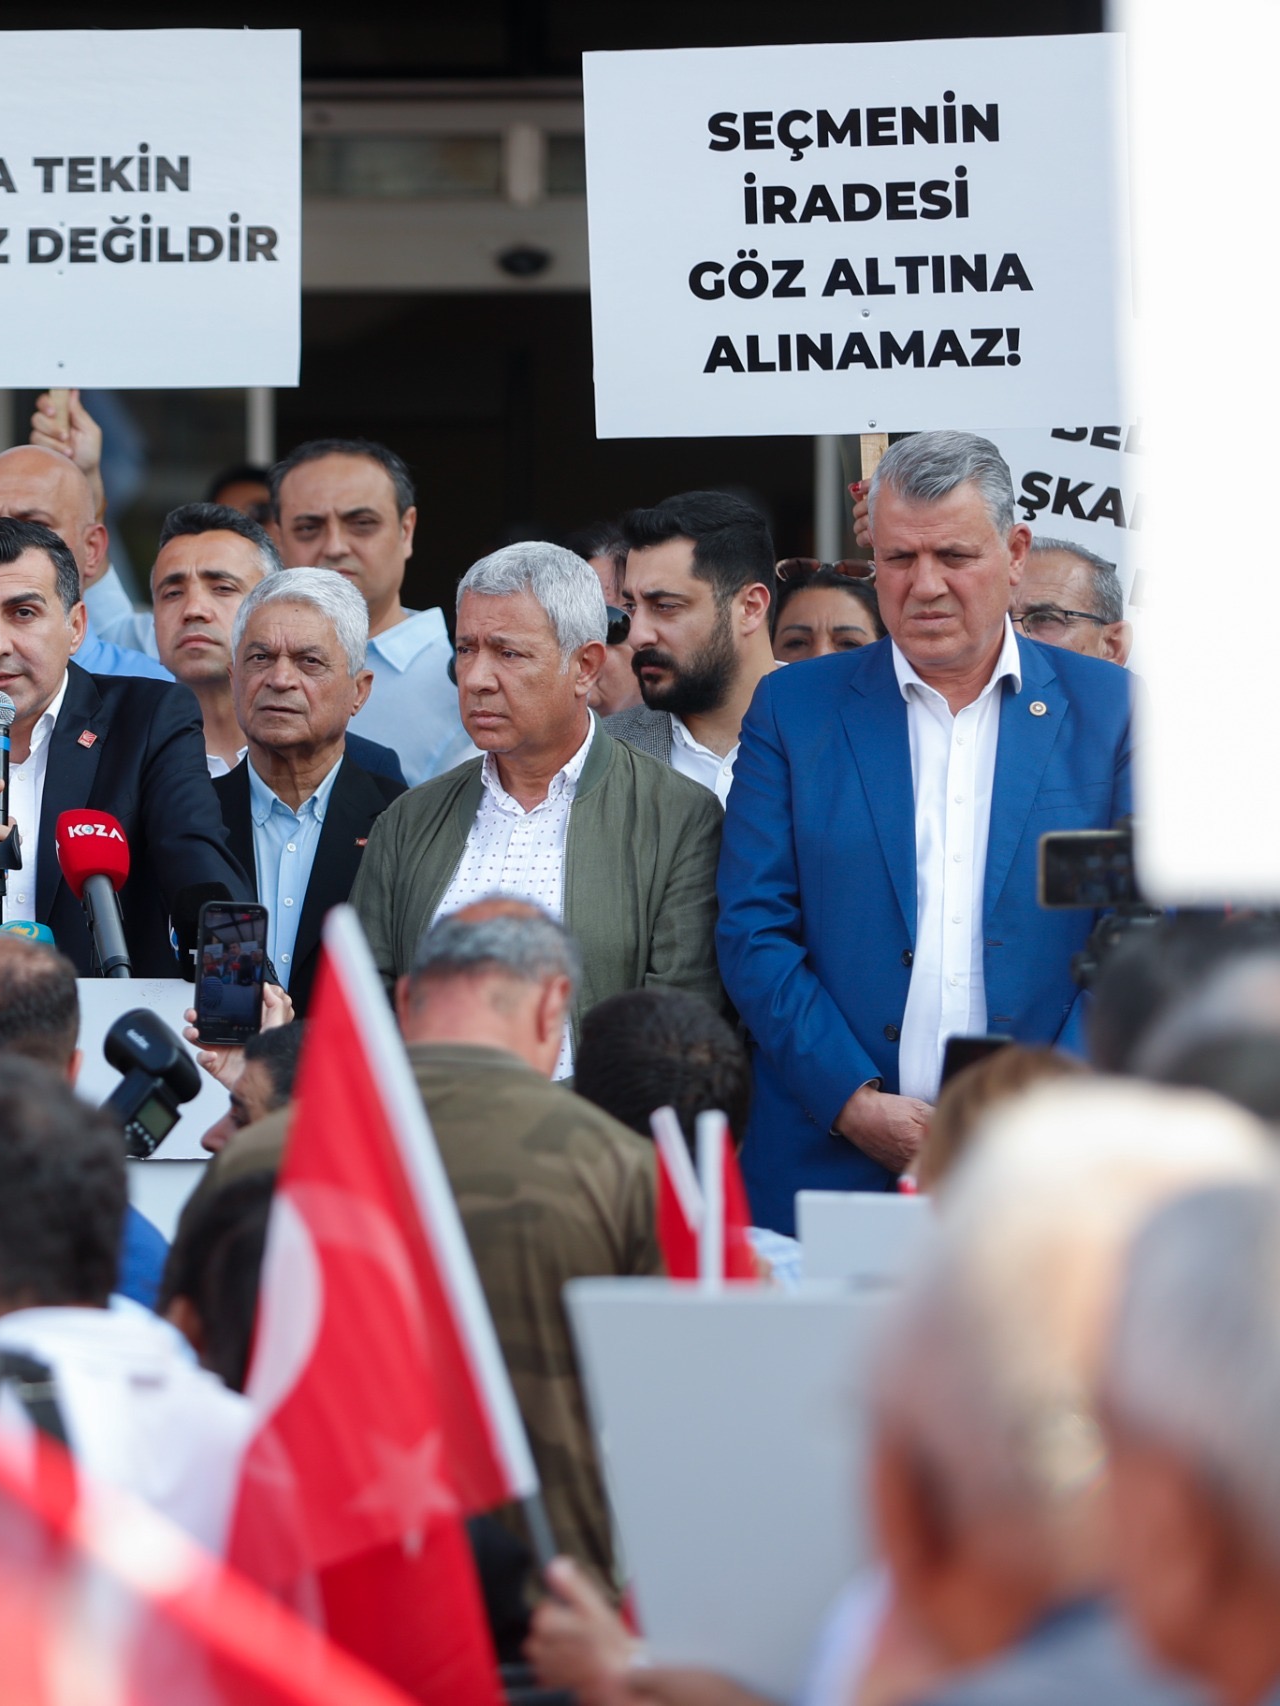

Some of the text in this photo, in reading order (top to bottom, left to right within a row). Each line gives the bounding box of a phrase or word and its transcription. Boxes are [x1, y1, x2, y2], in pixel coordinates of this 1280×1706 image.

[707, 89, 1000, 162] SEÇMENİN
[32, 141, 190, 194] TEKİN
[743, 164, 970, 225] İRADESİ
[27, 212, 278, 264] DEĞİLDİR
[688, 248, 1035, 301] GÖZ ALTINA
[702, 327, 1022, 374] ALINAMAZ!
[67, 823, 125, 843] KOZA
